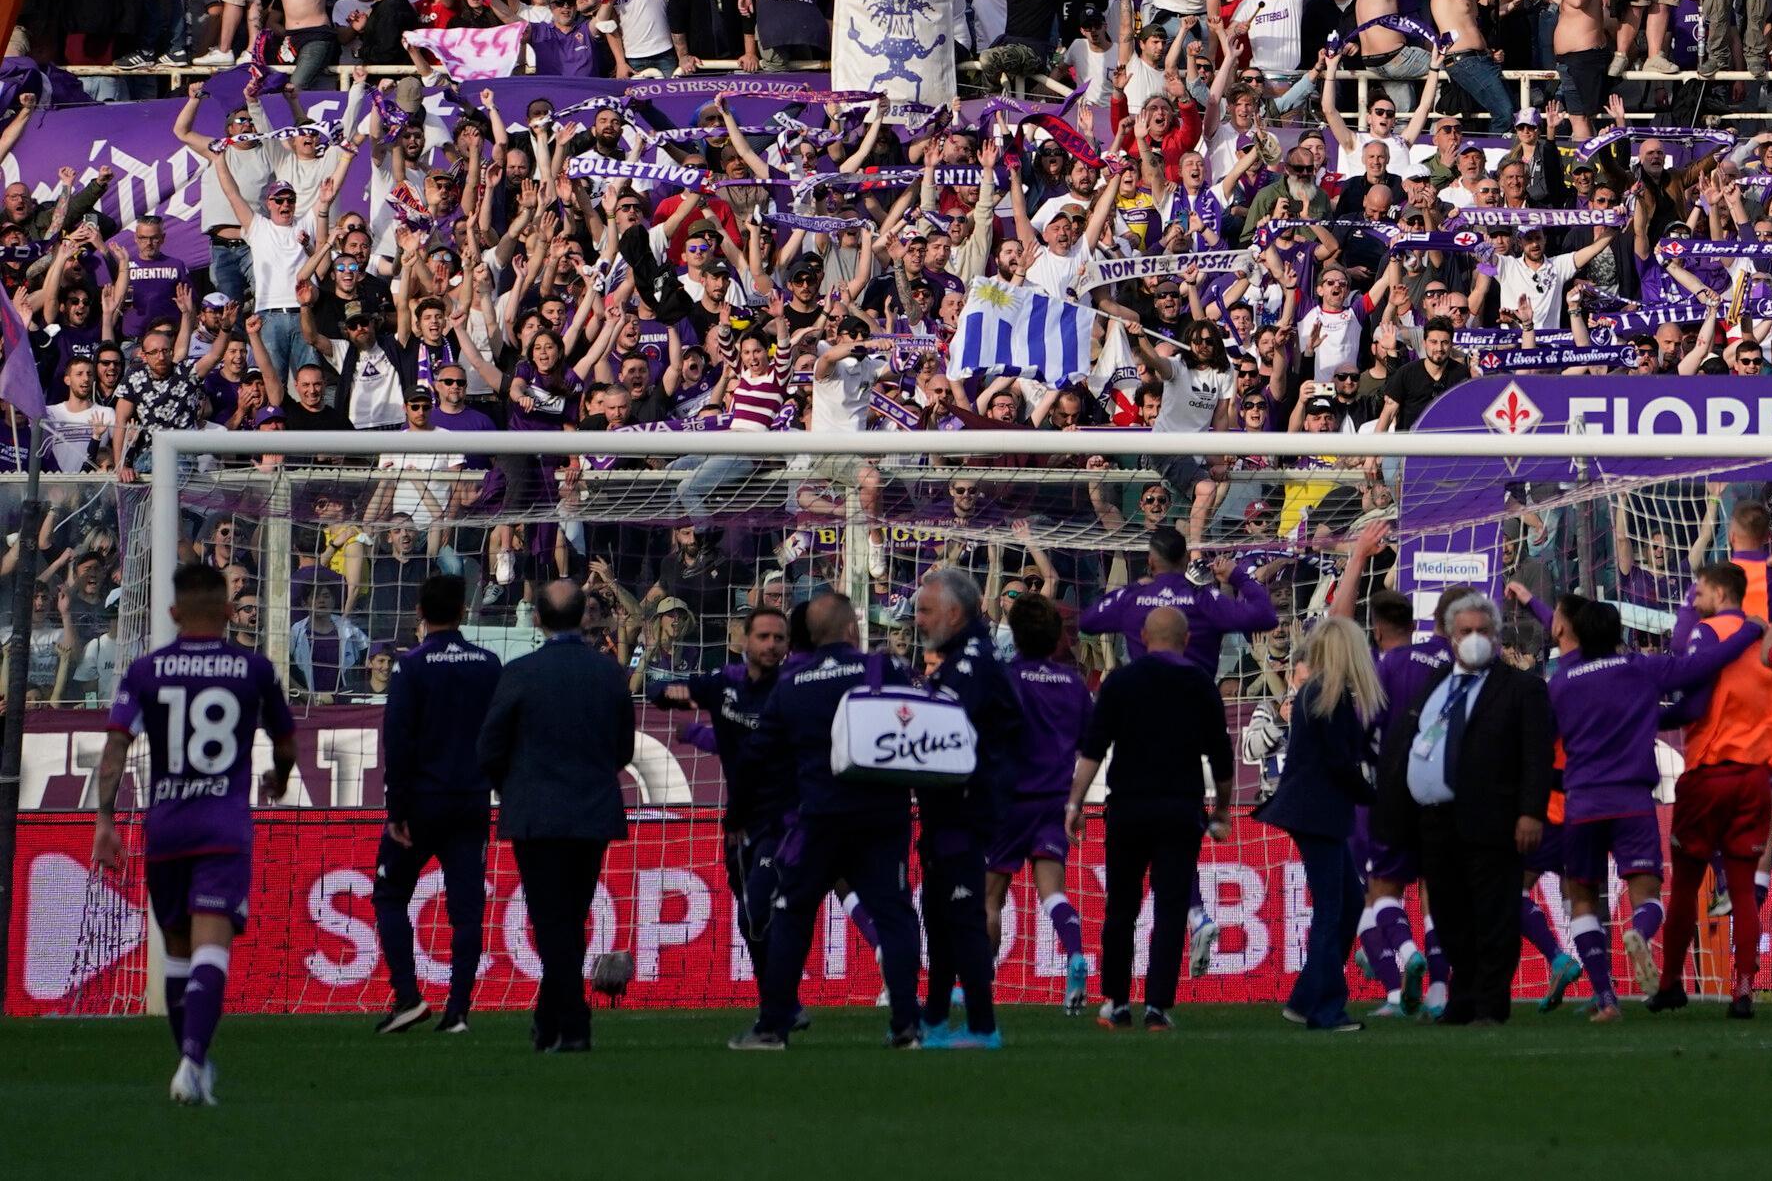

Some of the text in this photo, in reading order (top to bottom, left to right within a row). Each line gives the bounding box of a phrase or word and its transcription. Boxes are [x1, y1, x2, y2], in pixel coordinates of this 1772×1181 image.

[665, 80, 762, 97] STRESSATO
[568, 157, 700, 186] COLLETTIVO
[1750, 177, 1772, 188] ACF
[1461, 209, 1617, 227] VIOLA SI NASCE
[1690, 242, 1739, 255] Liberi
[1741, 243, 1759, 255] di
[129, 265, 179, 281] ORENTINA
[1100, 250, 1241, 281] NON SI PASSA!
[1505, 349, 1544, 367] Liberi
[1545, 350, 1559, 365] di
[1188, 399, 1215, 411] adidas
[1416, 561, 1479, 575] Mediacom
[1136, 597, 1195, 609] FIORENTINA
[426, 651, 489, 664] FIORENTINA
[1409, 652, 1441, 668] FIORE
[154, 655, 249, 679] TORREIRA
[794, 663, 866, 686] FIORENTINA
[1566, 657, 1629, 679] FIORENTINA
[1020, 670, 1074, 684] FIORENTINA
[156, 685, 242, 775] 18
[874, 730, 963, 765] Sixtus
[154, 774, 231, 803] prima
[304, 867, 845, 989] SCOPI
